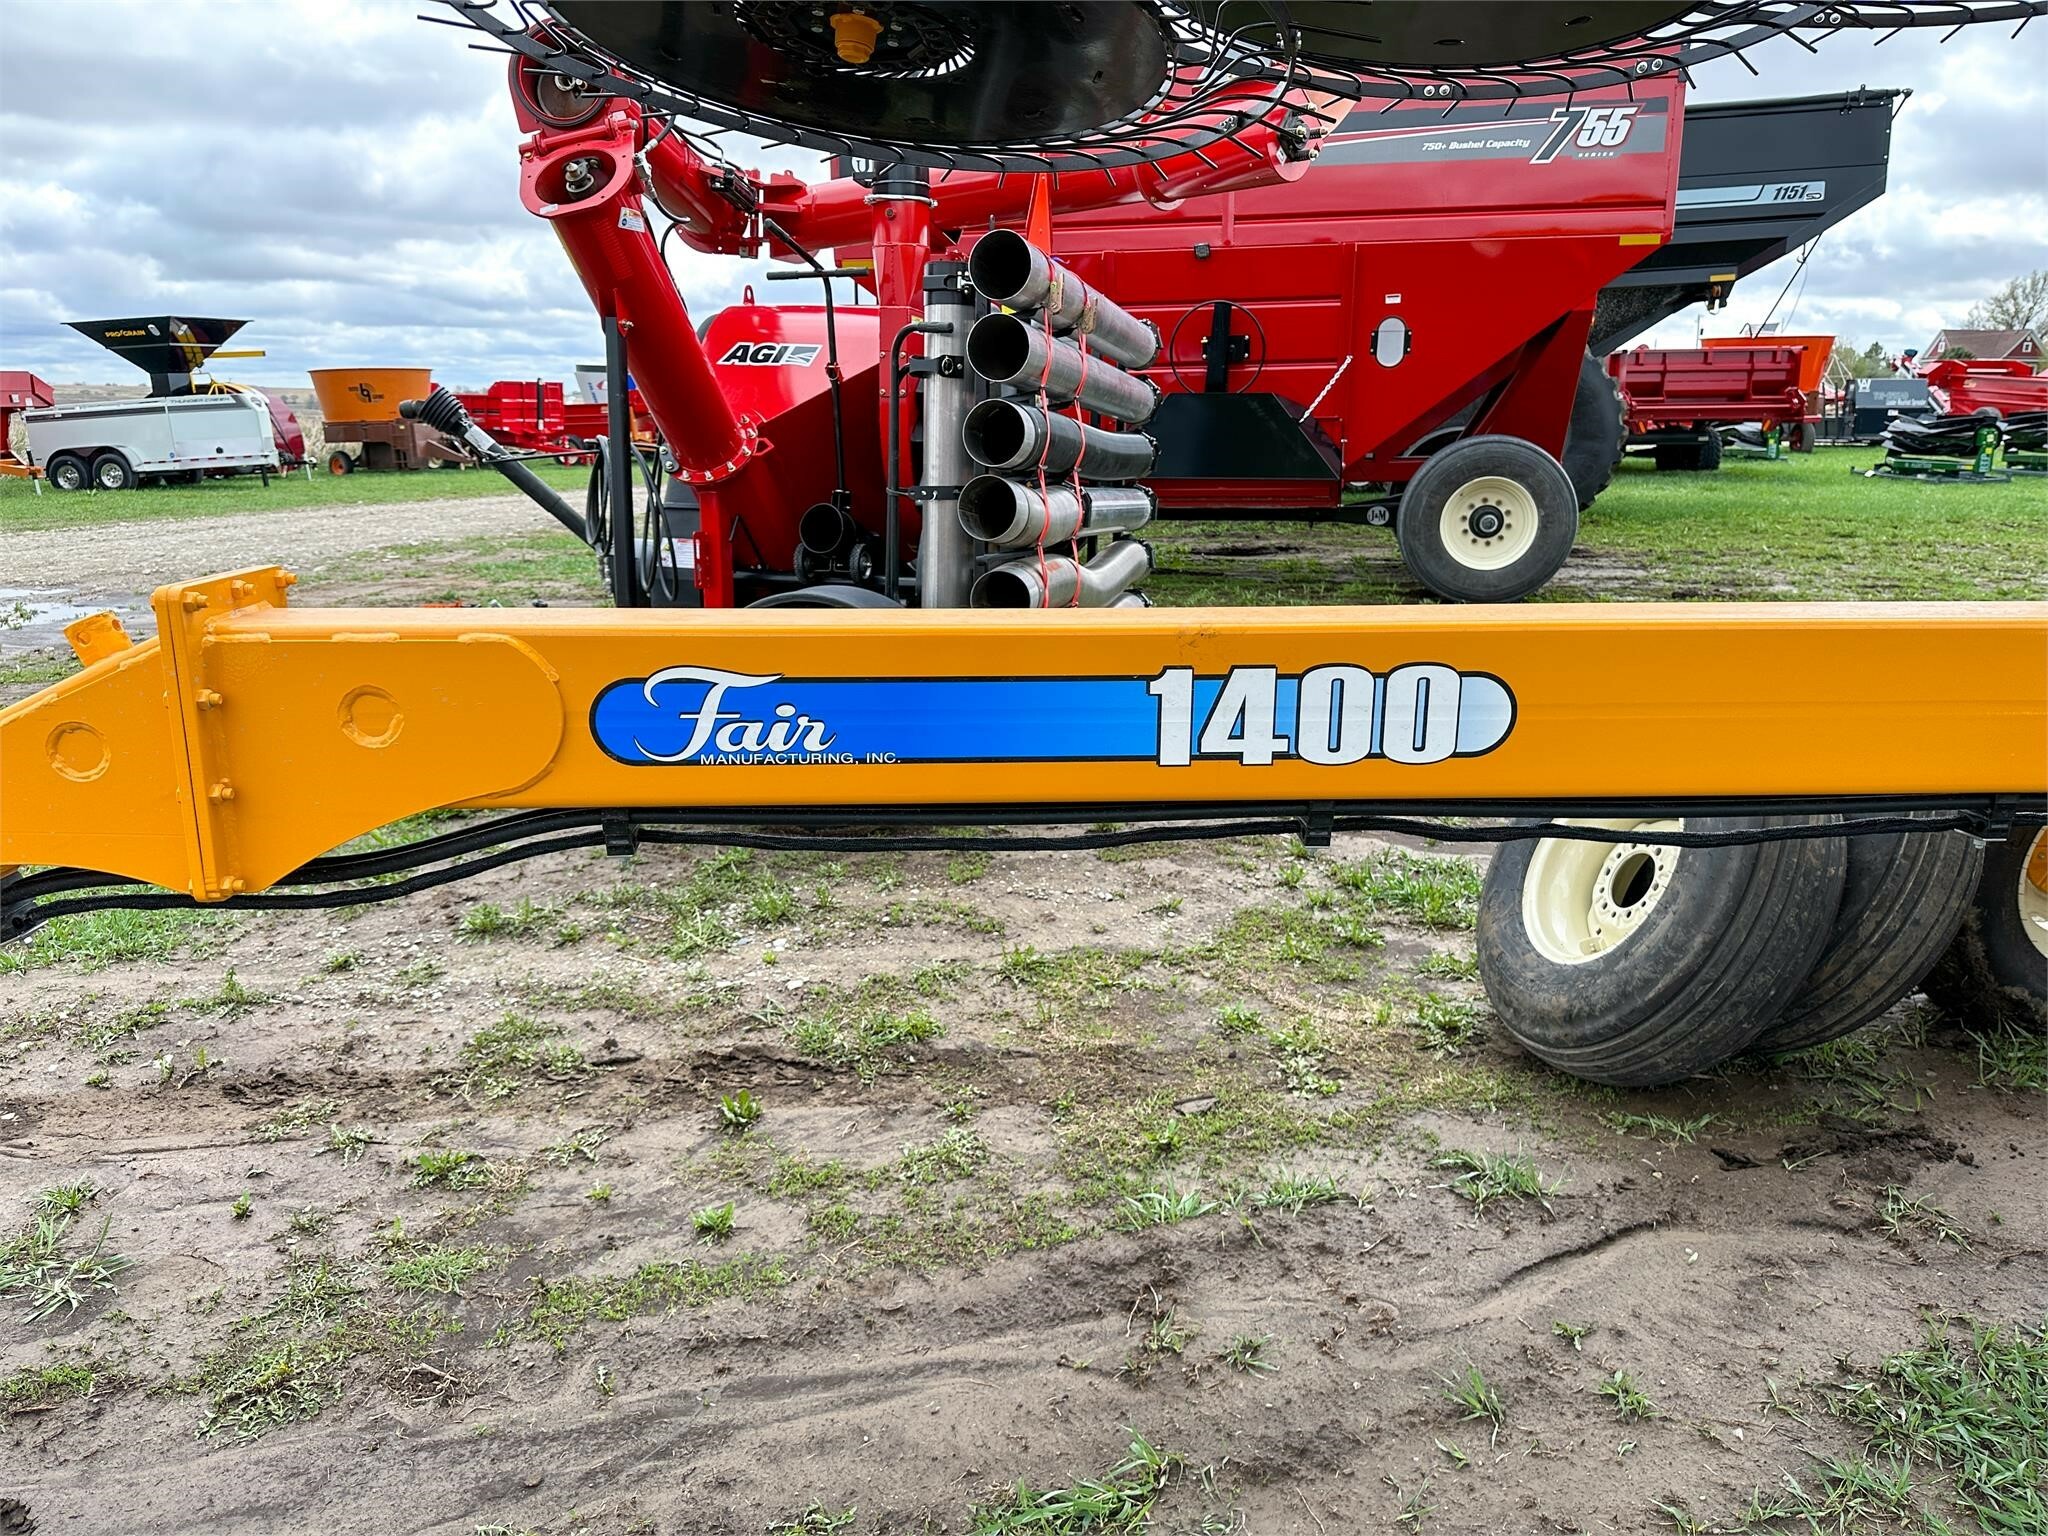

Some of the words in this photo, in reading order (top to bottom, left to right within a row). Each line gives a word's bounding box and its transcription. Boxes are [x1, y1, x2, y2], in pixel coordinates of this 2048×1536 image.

[1422, 142, 1447, 151] 750+
[1449, 140, 1485, 150] Bushel
[1486, 138, 1531, 149] Capacity
[1529, 106, 1638, 164] 755
[1773, 184, 1809, 201] 1151
[721, 343, 790, 364] AGI
[633, 664, 838, 762] Fair
[1146, 662, 1462, 766] 1400
[700, 752, 859, 766] MANUFACTURING,
[865, 752, 901, 764] INC.
